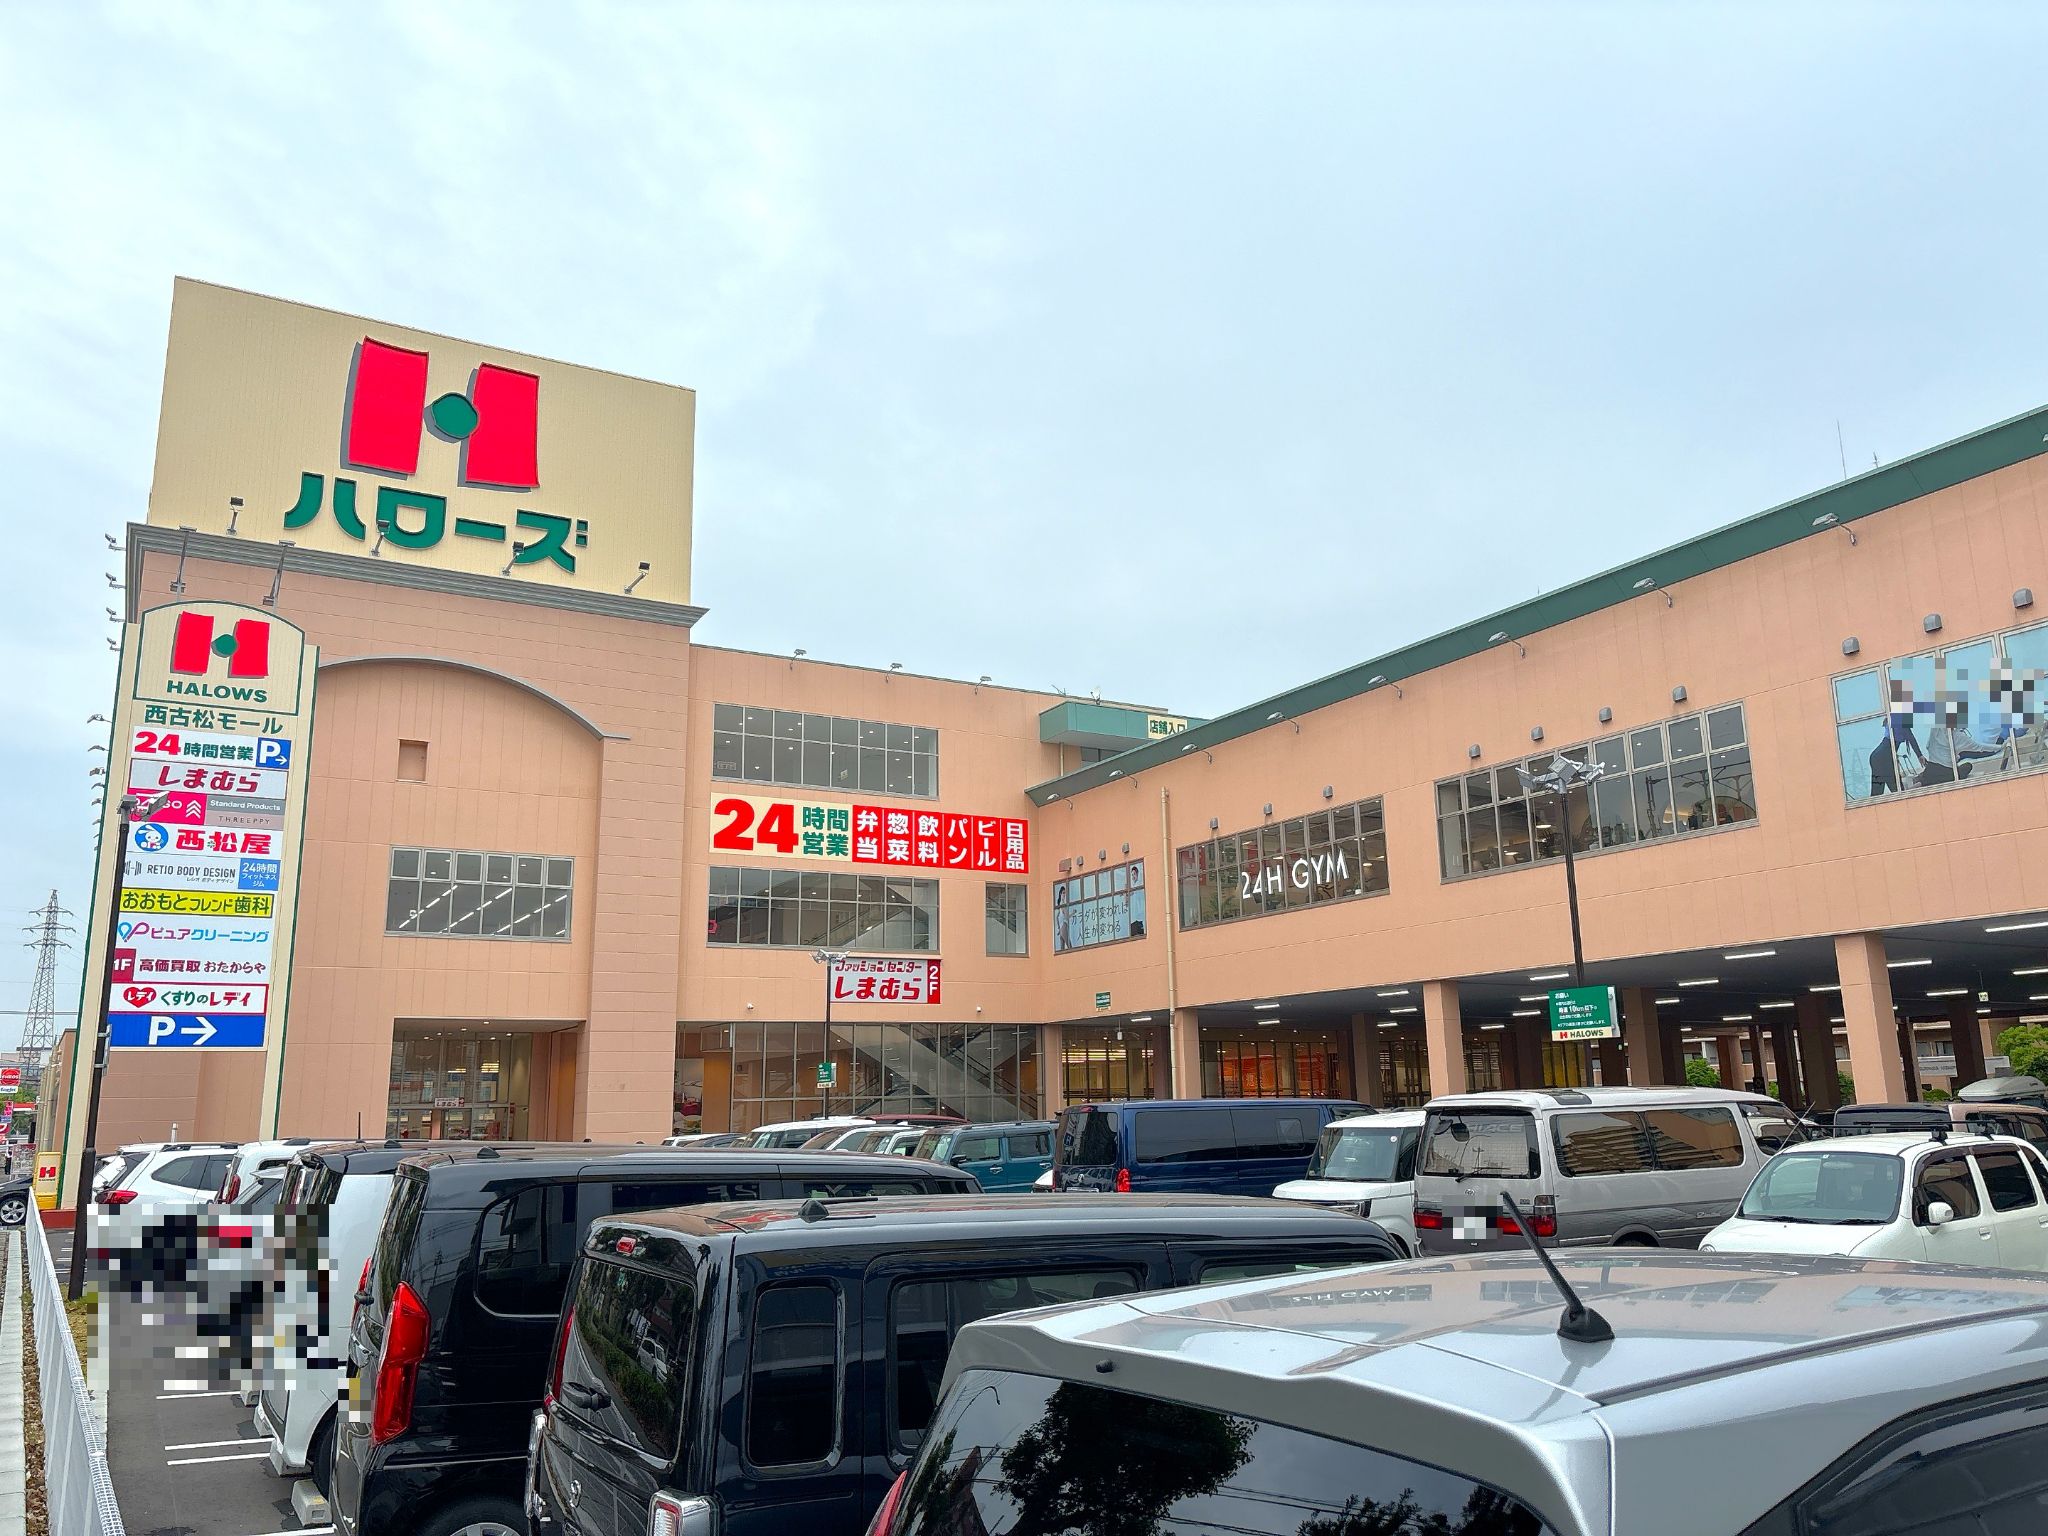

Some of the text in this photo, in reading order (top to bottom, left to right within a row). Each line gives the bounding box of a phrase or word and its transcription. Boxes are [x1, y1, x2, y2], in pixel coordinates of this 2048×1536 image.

[283, 471, 589, 575] ハローズ
[167, 680, 268, 703] HALOWS
[144, 704, 284, 735] 西古松モール
[134, 731, 254, 761] 24時間営業
[259, 741, 281, 764] P
[158, 766, 261, 793] しまむら
[210, 799, 281, 811] Standard Products
[219, 815, 270, 825] THREEPPY
[713, 798, 799, 853] 24
[802, 806, 849, 832] 時間
[176, 828, 272, 854] 西松屋
[802, 831, 849, 857] 営業
[856, 810, 878, 860] 弁当
[887, 811, 910, 862] 惣菜
[917, 815, 939, 863] 飲料
[948, 818, 969, 864] パン
[977, 820, 997, 867] ビール
[1005, 822, 1025, 871] 日用品
[147, 864, 236, 879] RETIO BODY DESIGN
[242, 862, 278, 874] 24時間
[242, 873, 277, 881] フィットネス
[1241, 848, 1350, 899] 24H GYM
[252, 880, 265, 888] ジム
[122, 892, 270, 915] おおもとフレンド歯科
[151, 926, 269, 943] ピュアクリーニング
[139, 959, 266, 974] 高価買取 おたからや
[835, 959, 923, 974] ファッションセンター
[160, 990, 251, 1007] くすりのレディ
[835, 976, 922, 1000] しまむら
[148, 1016, 176, 1046] P
[1570, 1030, 1604, 1038] HALOWS
